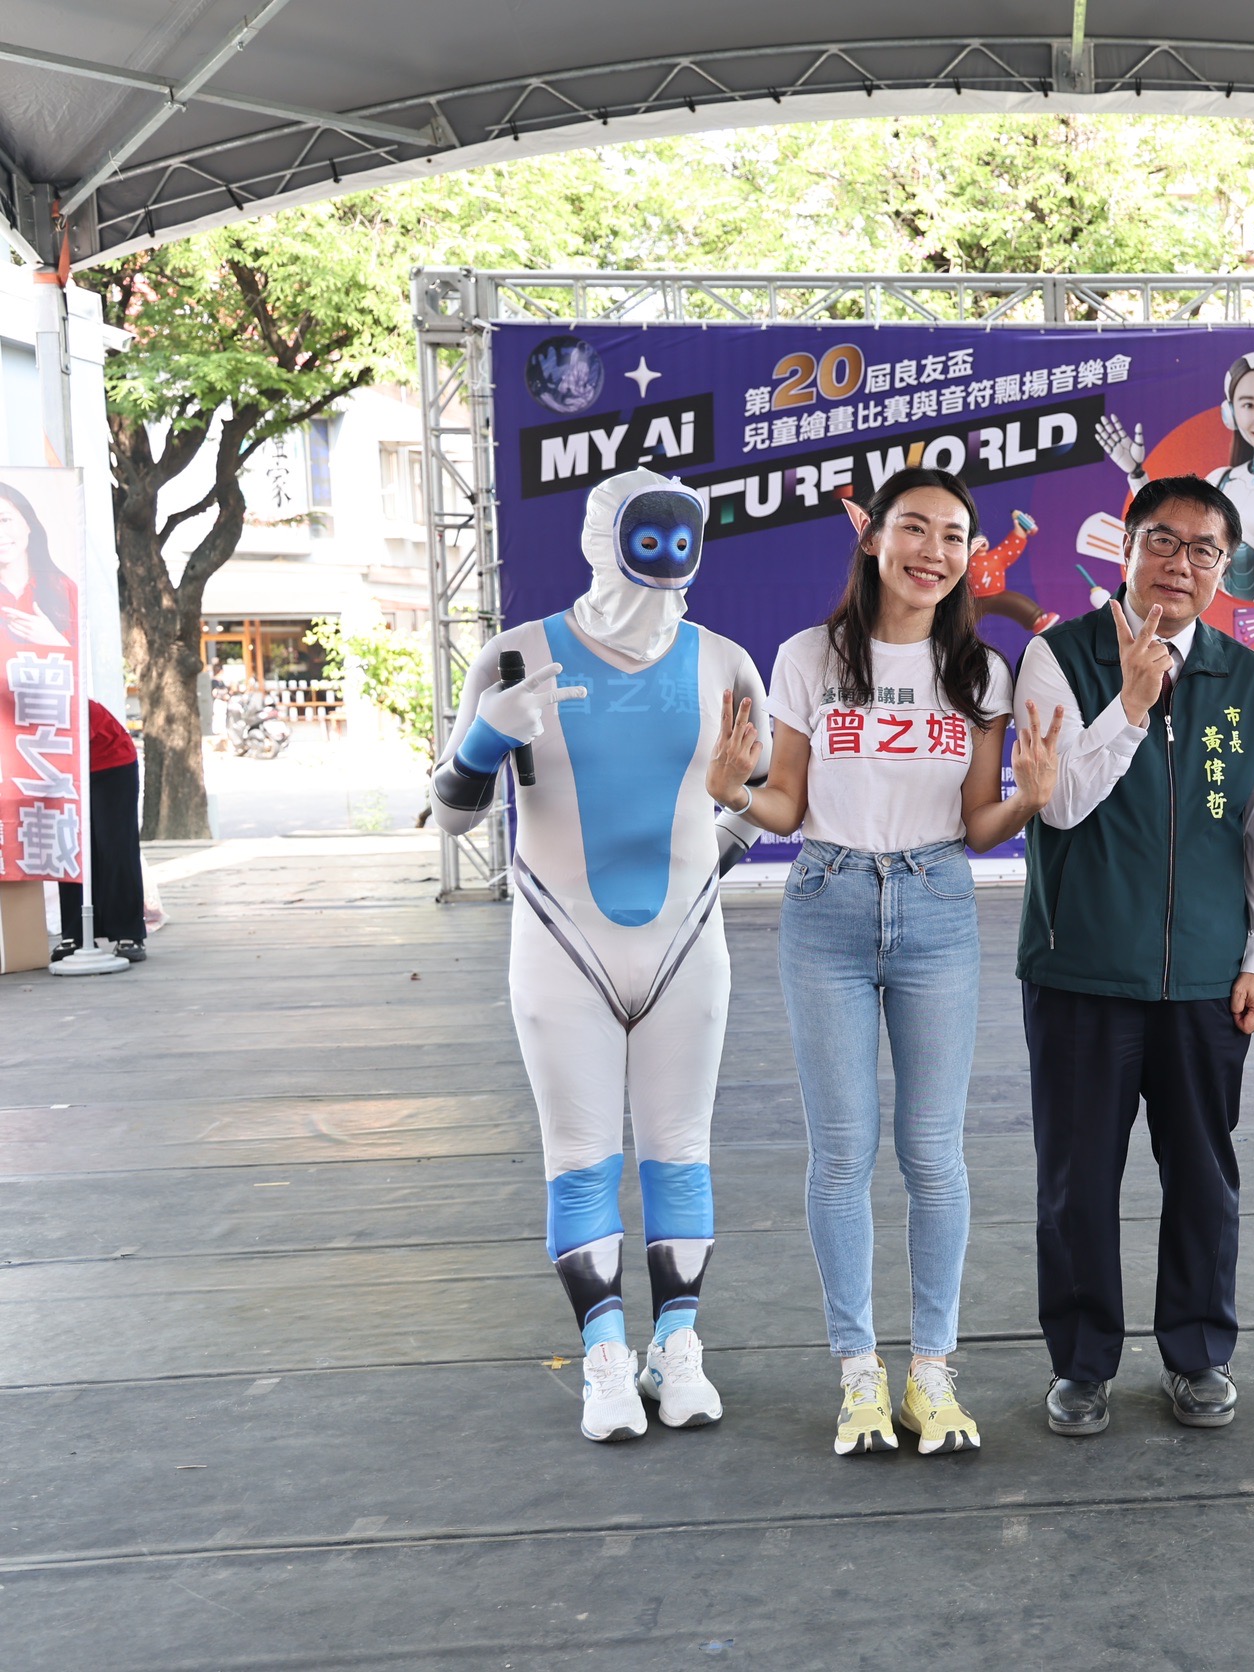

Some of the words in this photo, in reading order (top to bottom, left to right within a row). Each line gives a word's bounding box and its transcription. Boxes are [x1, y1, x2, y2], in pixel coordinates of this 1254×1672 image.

[742, 353, 1132, 453] 兒童繪畫比賽與音符飄揚音樂會
[744, 343, 975, 418] 第20屆良友盃
[540, 424, 629, 482] MY
[696, 456, 854, 526] TURE
[866, 411, 1078, 487] WORLD
[554, 671, 699, 714] 曾之婕
[826, 708, 967, 757] 曾之婕
[1223, 706, 1244, 753] 市長
[1201, 725, 1227, 819] 黃偉哲
